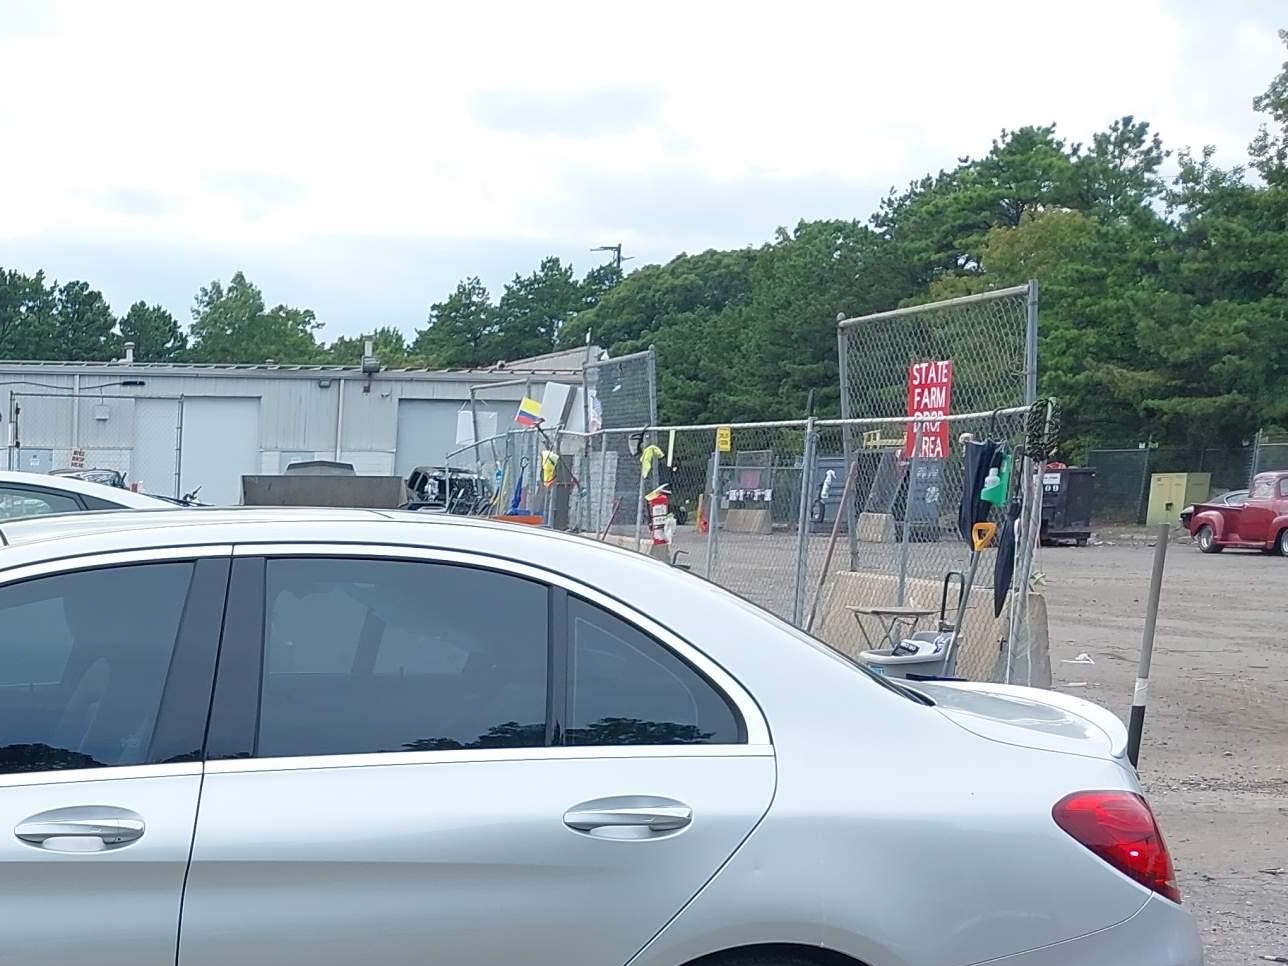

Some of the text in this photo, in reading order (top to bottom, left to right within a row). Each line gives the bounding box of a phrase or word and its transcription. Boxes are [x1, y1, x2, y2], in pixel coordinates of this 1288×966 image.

[913, 361, 949, 385] STATE
[914, 386, 946, 410] FARM
[911, 436, 943, 458] REA
